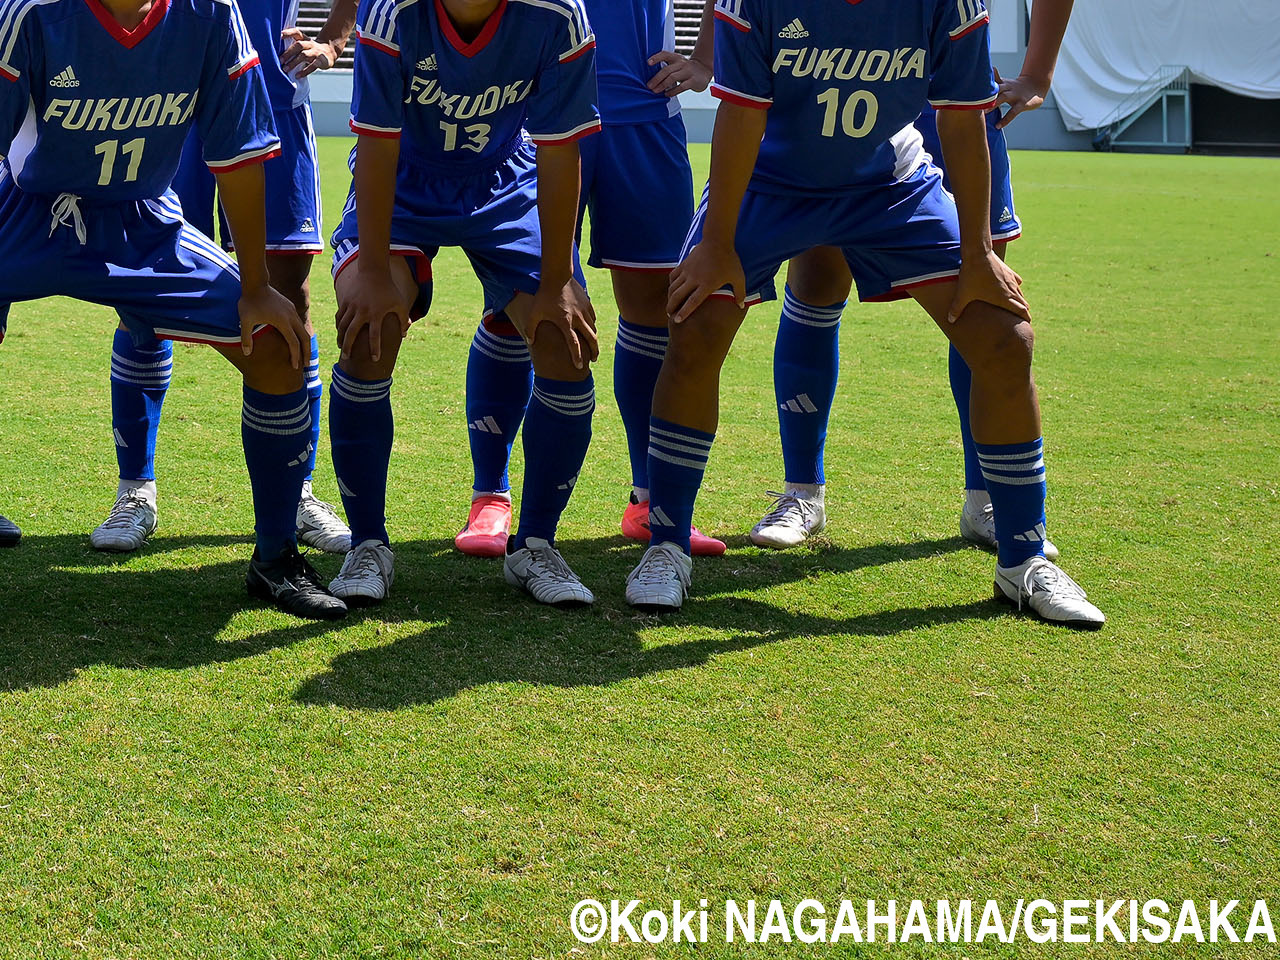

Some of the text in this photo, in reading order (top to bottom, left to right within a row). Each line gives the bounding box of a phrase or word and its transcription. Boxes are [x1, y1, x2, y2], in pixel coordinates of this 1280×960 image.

[778, 30, 810, 39] adidas
[772, 47, 927, 82] FUKUOKA
[49, 79, 81, 88] adidas
[817, 87, 879, 138] 10
[439, 120, 491, 153] 13
[94, 137, 146, 186] 11
